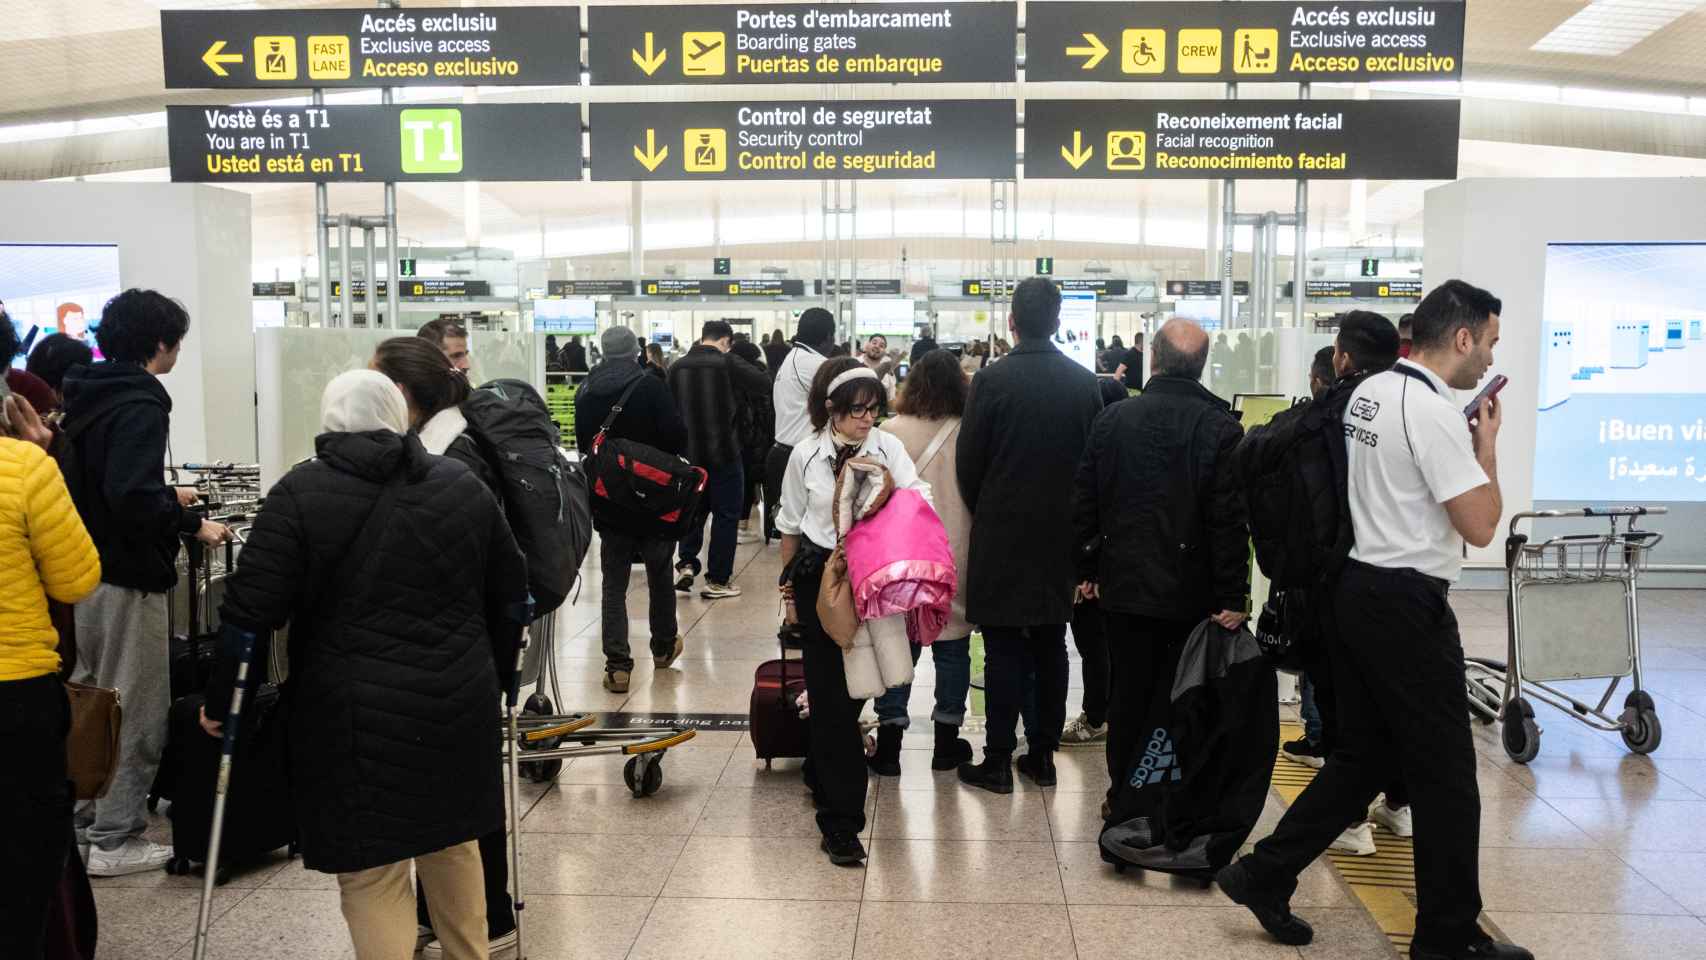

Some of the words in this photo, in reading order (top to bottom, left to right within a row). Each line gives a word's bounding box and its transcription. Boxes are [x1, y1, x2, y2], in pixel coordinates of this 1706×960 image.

[361, 13, 416, 33] Accés
[422, 13, 496, 32] exclusiu
[737, 10, 796, 28] Portes
[803, 9, 951, 28] d'embarcament
[1291, 6, 1350, 26] Accés
[1357, 7, 1435, 26] exclusiu
[314, 44, 343, 54] FAST
[361, 37, 433, 54] Exclusive
[438, 40, 490, 53] access
[737, 33, 809, 53] Boarding
[813, 34, 856, 53] gates
[1290, 31, 1366, 48] Exclusive
[1371, 34, 1426, 48] access
[1182, 46, 1218, 56] CREW
[313, 61, 344, 71] LANE
[363, 58, 428, 77] Acceso
[434, 57, 518, 76] exclusivo
[737, 55, 809, 73] Puertas
[816, 54, 839, 72] de
[846, 54, 942, 76] embarque
[1290, 53, 1359, 71] Acceso
[1366, 53, 1454, 72] exclusivo
[205, 109, 256, 128] Vostè
[262, 107, 283, 128] és
[289, 114, 300, 128] a
[305, 109, 330, 128] T1
[738, 107, 806, 126] Control
[813, 107, 836, 125] de
[843, 107, 932, 129] seguretat
[1157, 113, 1290, 129] Reconeixement
[1295, 113, 1342, 129] facial
[206, 133, 235, 150] You
[240, 137, 265, 149] are
[270, 133, 284, 149] in
[289, 132, 310, 149] T1
[404, 121, 460, 162] T1
[738, 128, 803, 150] Security
[808, 129, 862, 146] control
[1157, 133, 1194, 148] Facial
[1200, 134, 1273, 150] recognition
[207, 154, 260, 173] Usted
[267, 153, 304, 172] está
[311, 158, 333, 172] en
[339, 153, 363, 172] T1
[738, 149, 806, 170] Control
[813, 151, 836, 169] de
[843, 151, 935, 173] seguridad
[1156, 152, 1293, 169] Reconocimiento
[1298, 153, 1345, 169] facial
[1599, 418, 1674, 444] ¡Buen
[1681, 418, 1706, 441] vi
[630, 717, 713, 727] Boarding
[1130, 728, 1167, 789] adidas
